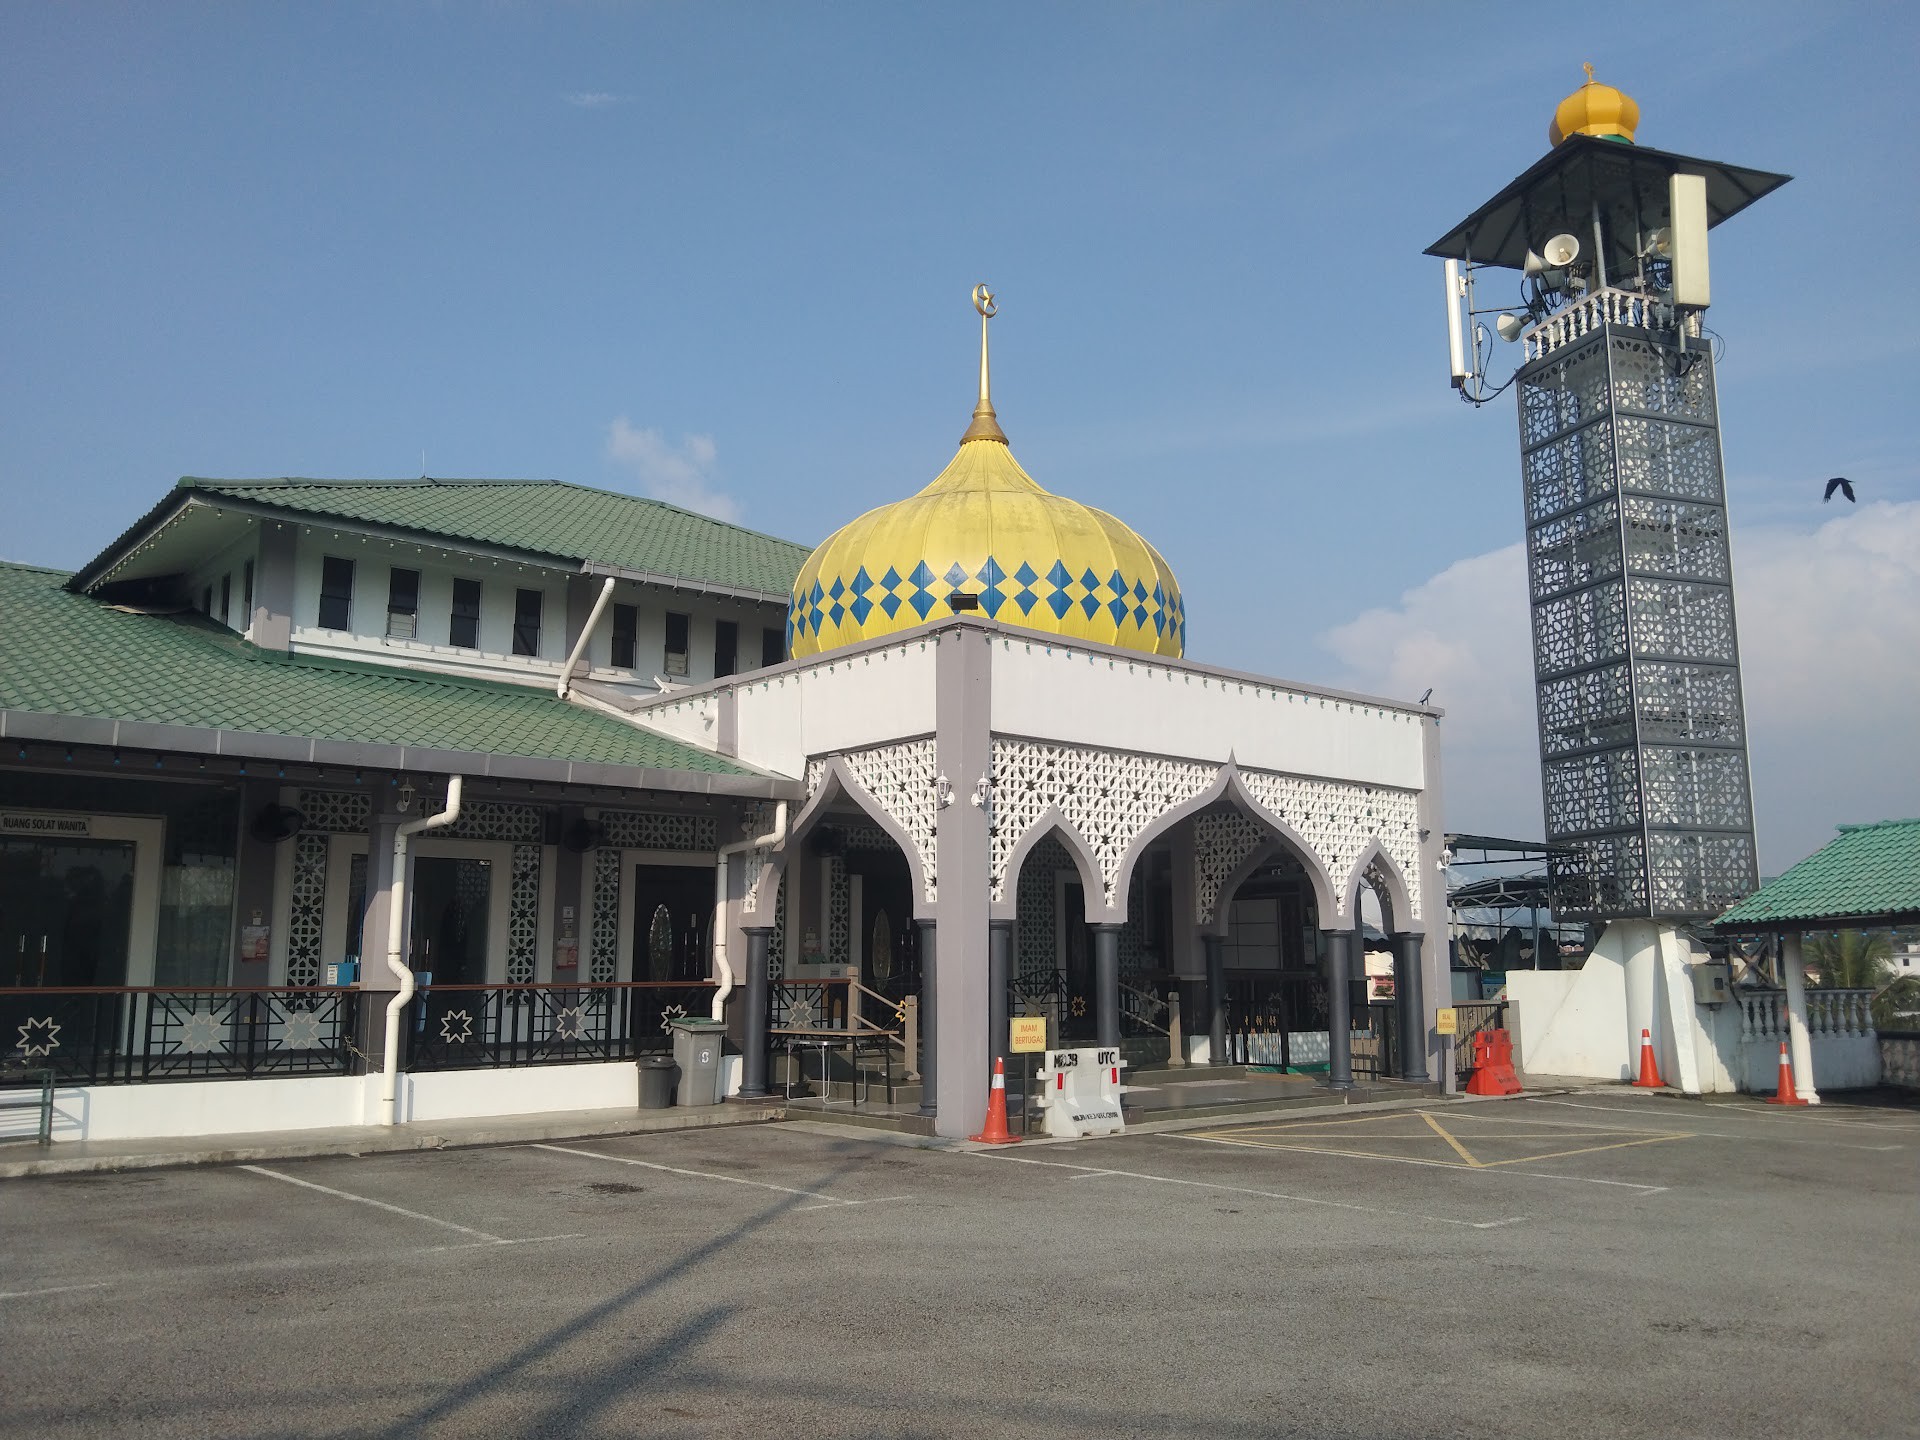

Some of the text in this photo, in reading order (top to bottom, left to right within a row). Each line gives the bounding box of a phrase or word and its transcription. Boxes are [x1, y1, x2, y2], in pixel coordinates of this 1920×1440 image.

[3, 817, 87, 832] RUANG SOLAT WANITA
[1020, 1024, 1038, 1033] IMAM
[1015, 1035, 1044, 1045] BERTUGAS
[1097, 1051, 1116, 1065] UTC
